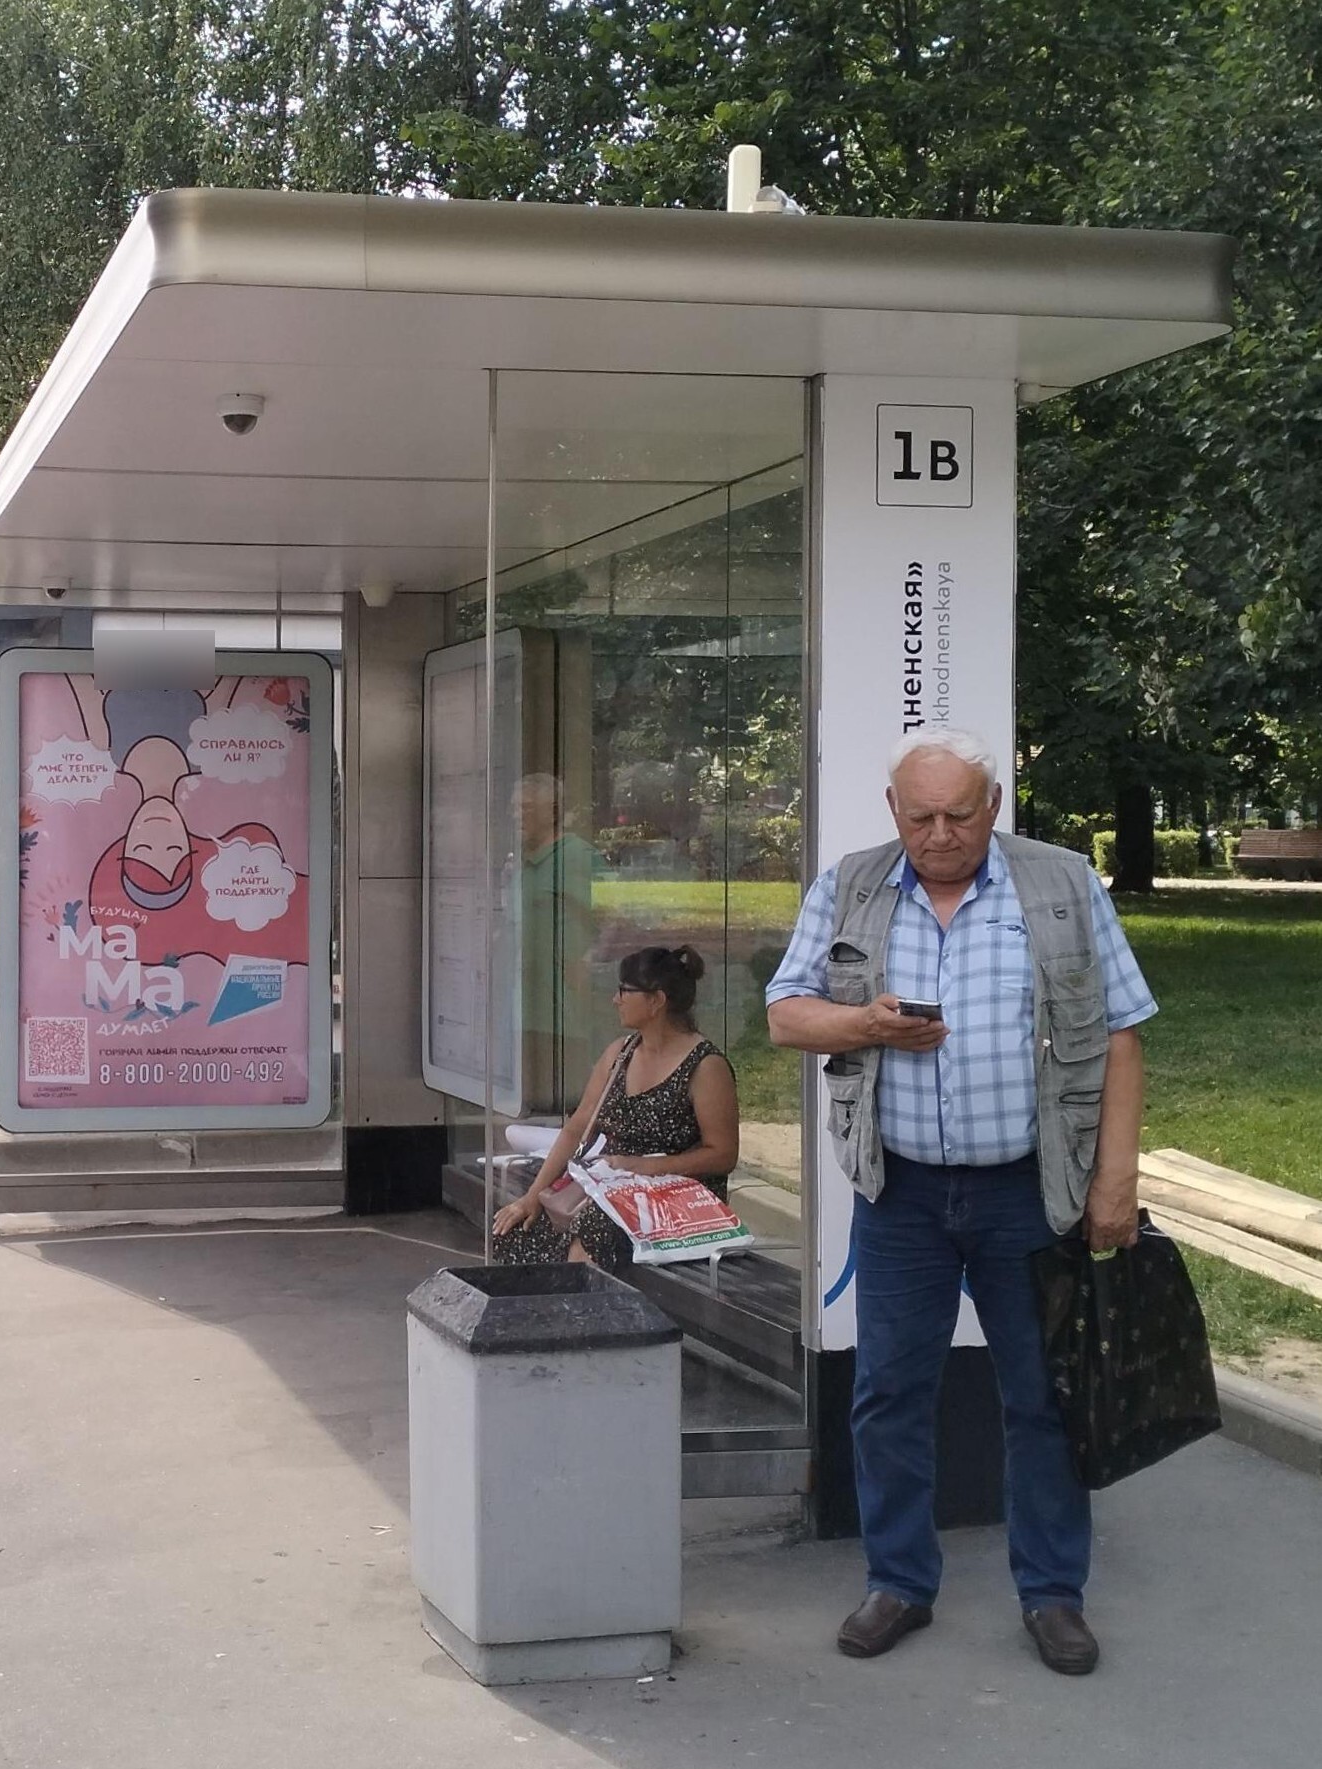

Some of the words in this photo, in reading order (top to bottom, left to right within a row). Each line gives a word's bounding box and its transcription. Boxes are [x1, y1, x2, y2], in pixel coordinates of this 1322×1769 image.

[893, 431, 960, 481] 1B
[931, 561, 954, 728] khodnenskaya
[199, 739, 285, 749] СПРАВЛЮСЬ
[61, 753, 84, 762] ЧТО
[224, 753, 241, 762] ЛИ
[37, 764, 63, 772] МНЕ
[69, 764, 108, 772] ТЕПЕРЬ
[47, 775, 98, 784] ДЕЛАТЬ?
[240, 865, 261, 874] ГДЕ
[215, 887, 285, 897] ПОДДЕРЖКУ?
[90, 906, 149, 924] БУДУЩАЯ
[96, 1016, 171, 1036] ДУМАЕТ
[240, 1046, 288, 1055] ОТВЕЧАЕТ
[99, 1061, 284, 1085] 8-800-2000-492
